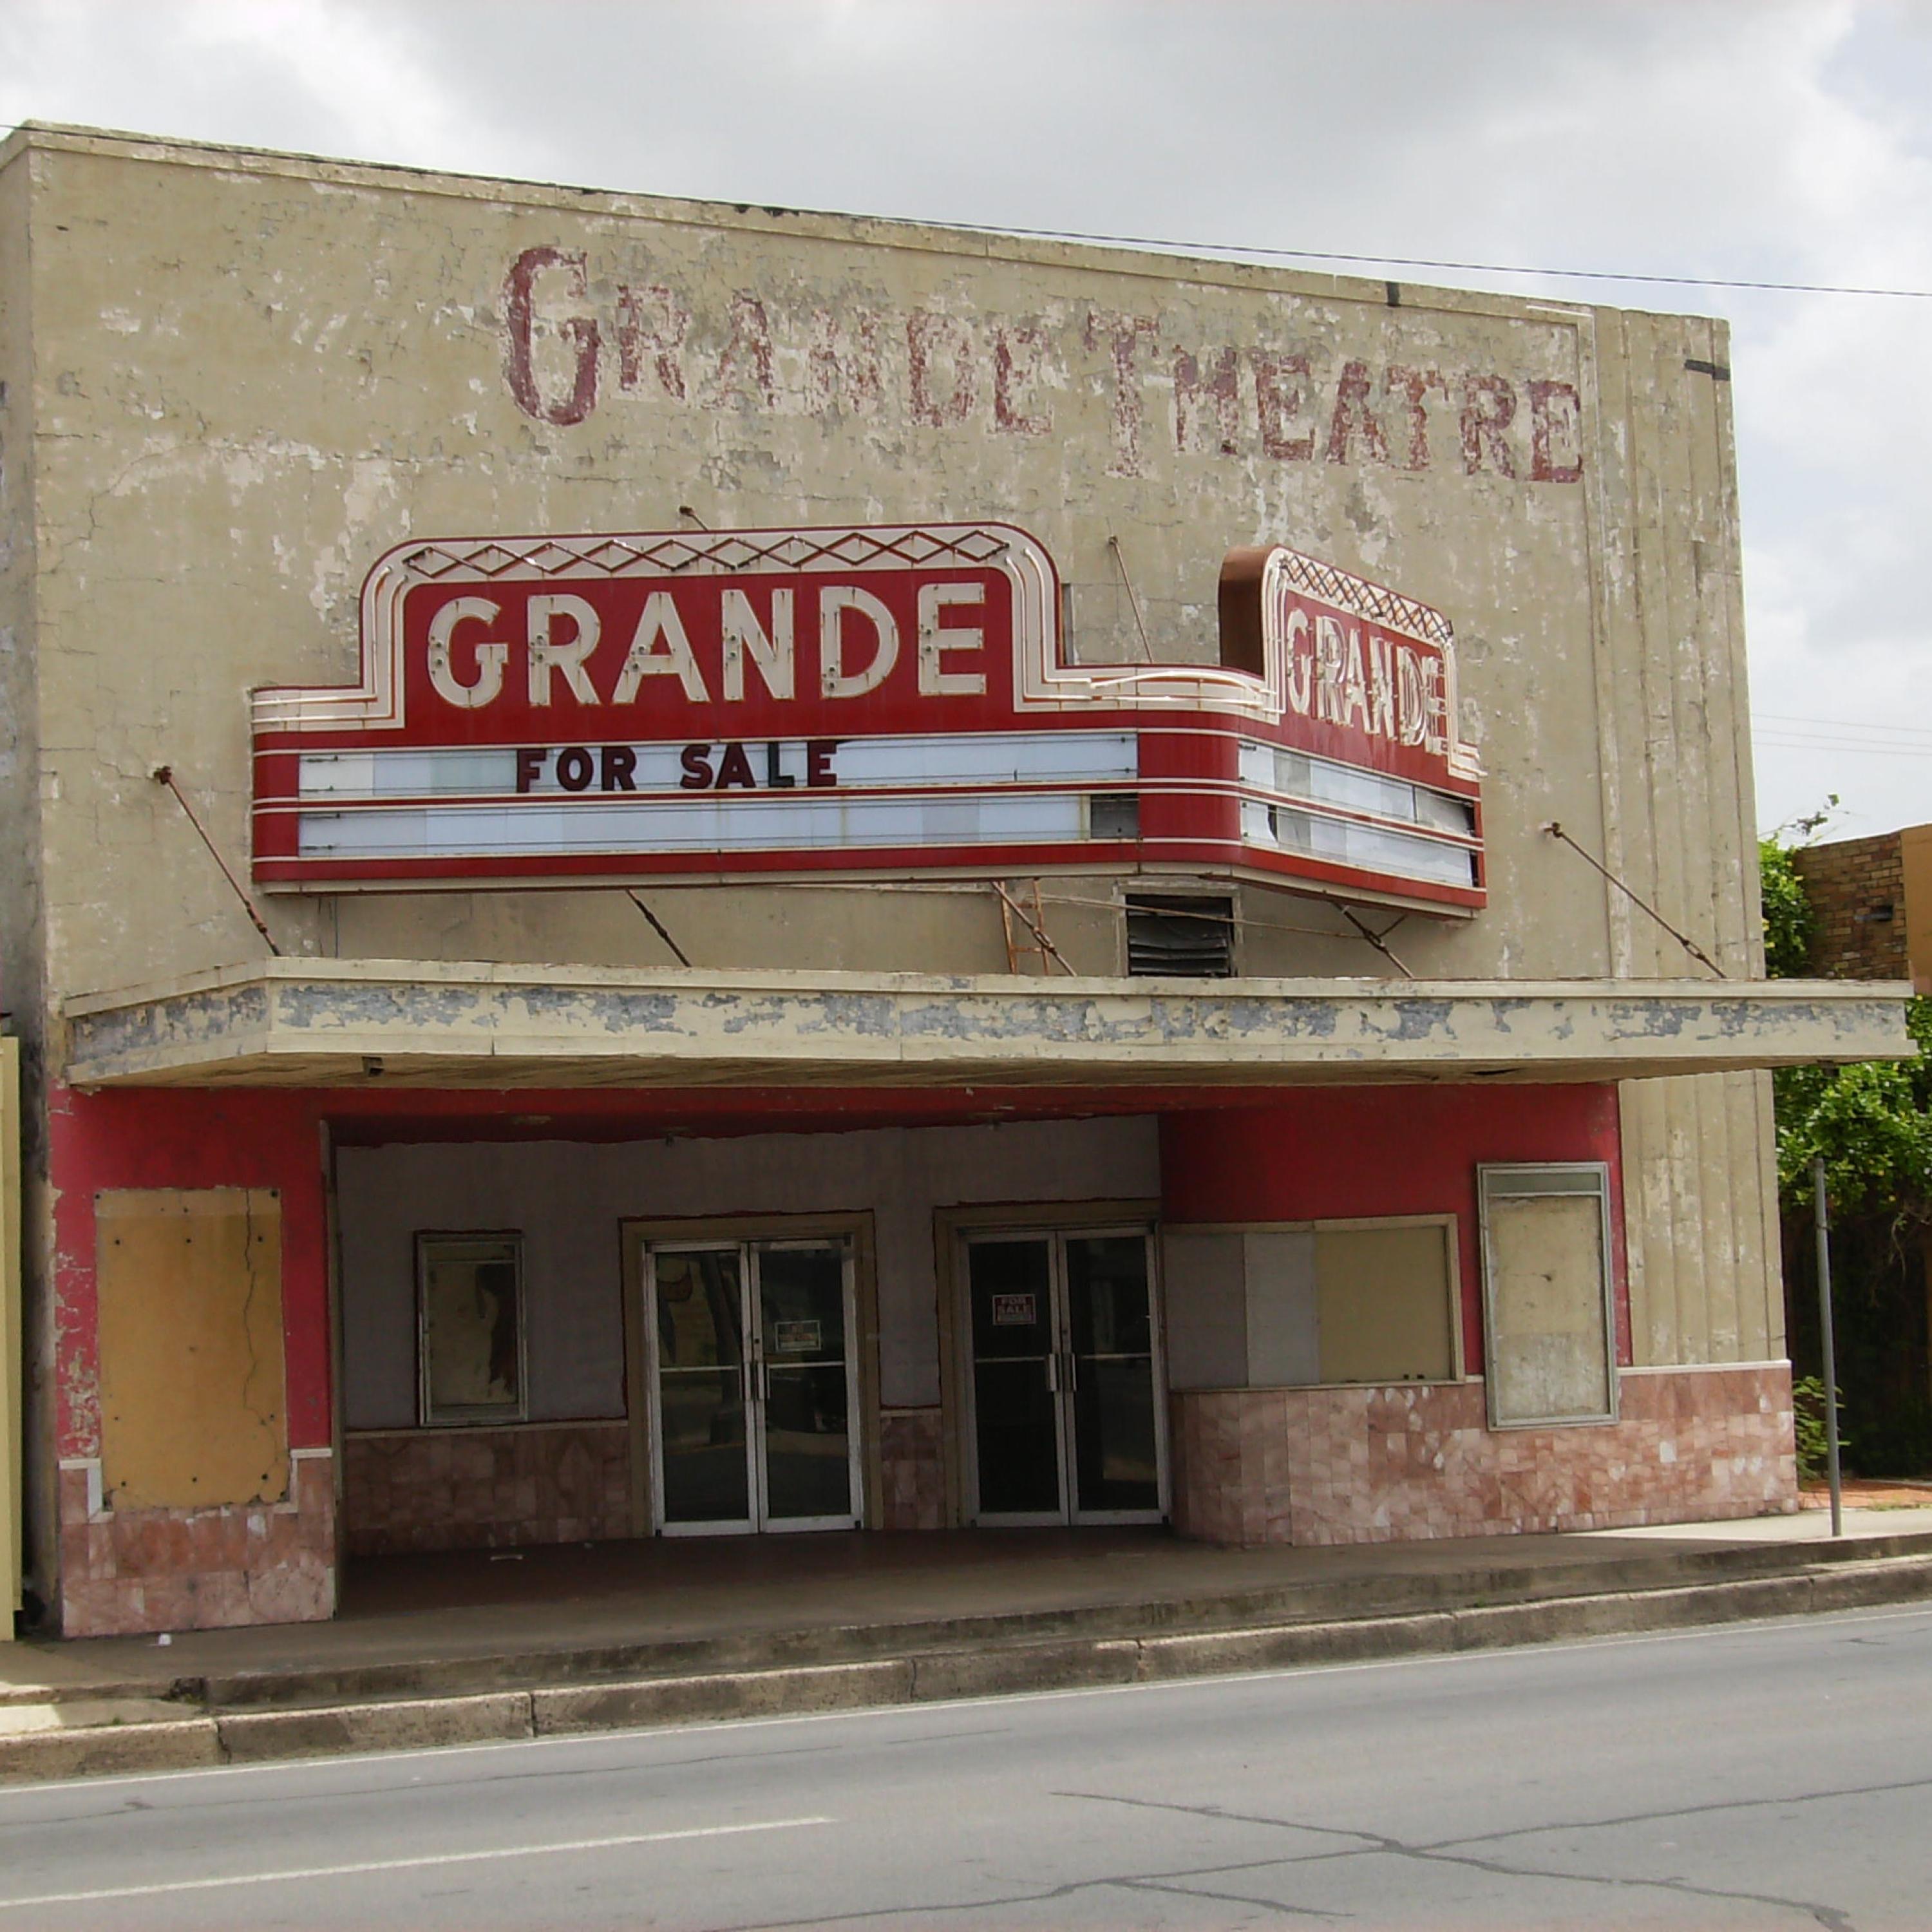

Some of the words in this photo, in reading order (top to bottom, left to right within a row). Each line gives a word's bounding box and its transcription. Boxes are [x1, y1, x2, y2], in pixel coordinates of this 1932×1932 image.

[501, 246, 1055, 435] GRANDE
[1083, 309, 1584, 484] THEATRE
[428, 582, 988, 709] GRANDE
[1286, 608, 1446, 756] GRANDE
[516, 745, 637, 793] FOR
[680, 741, 838, 789] SALE
[1000, 1296, 1027, 1305] FOR
